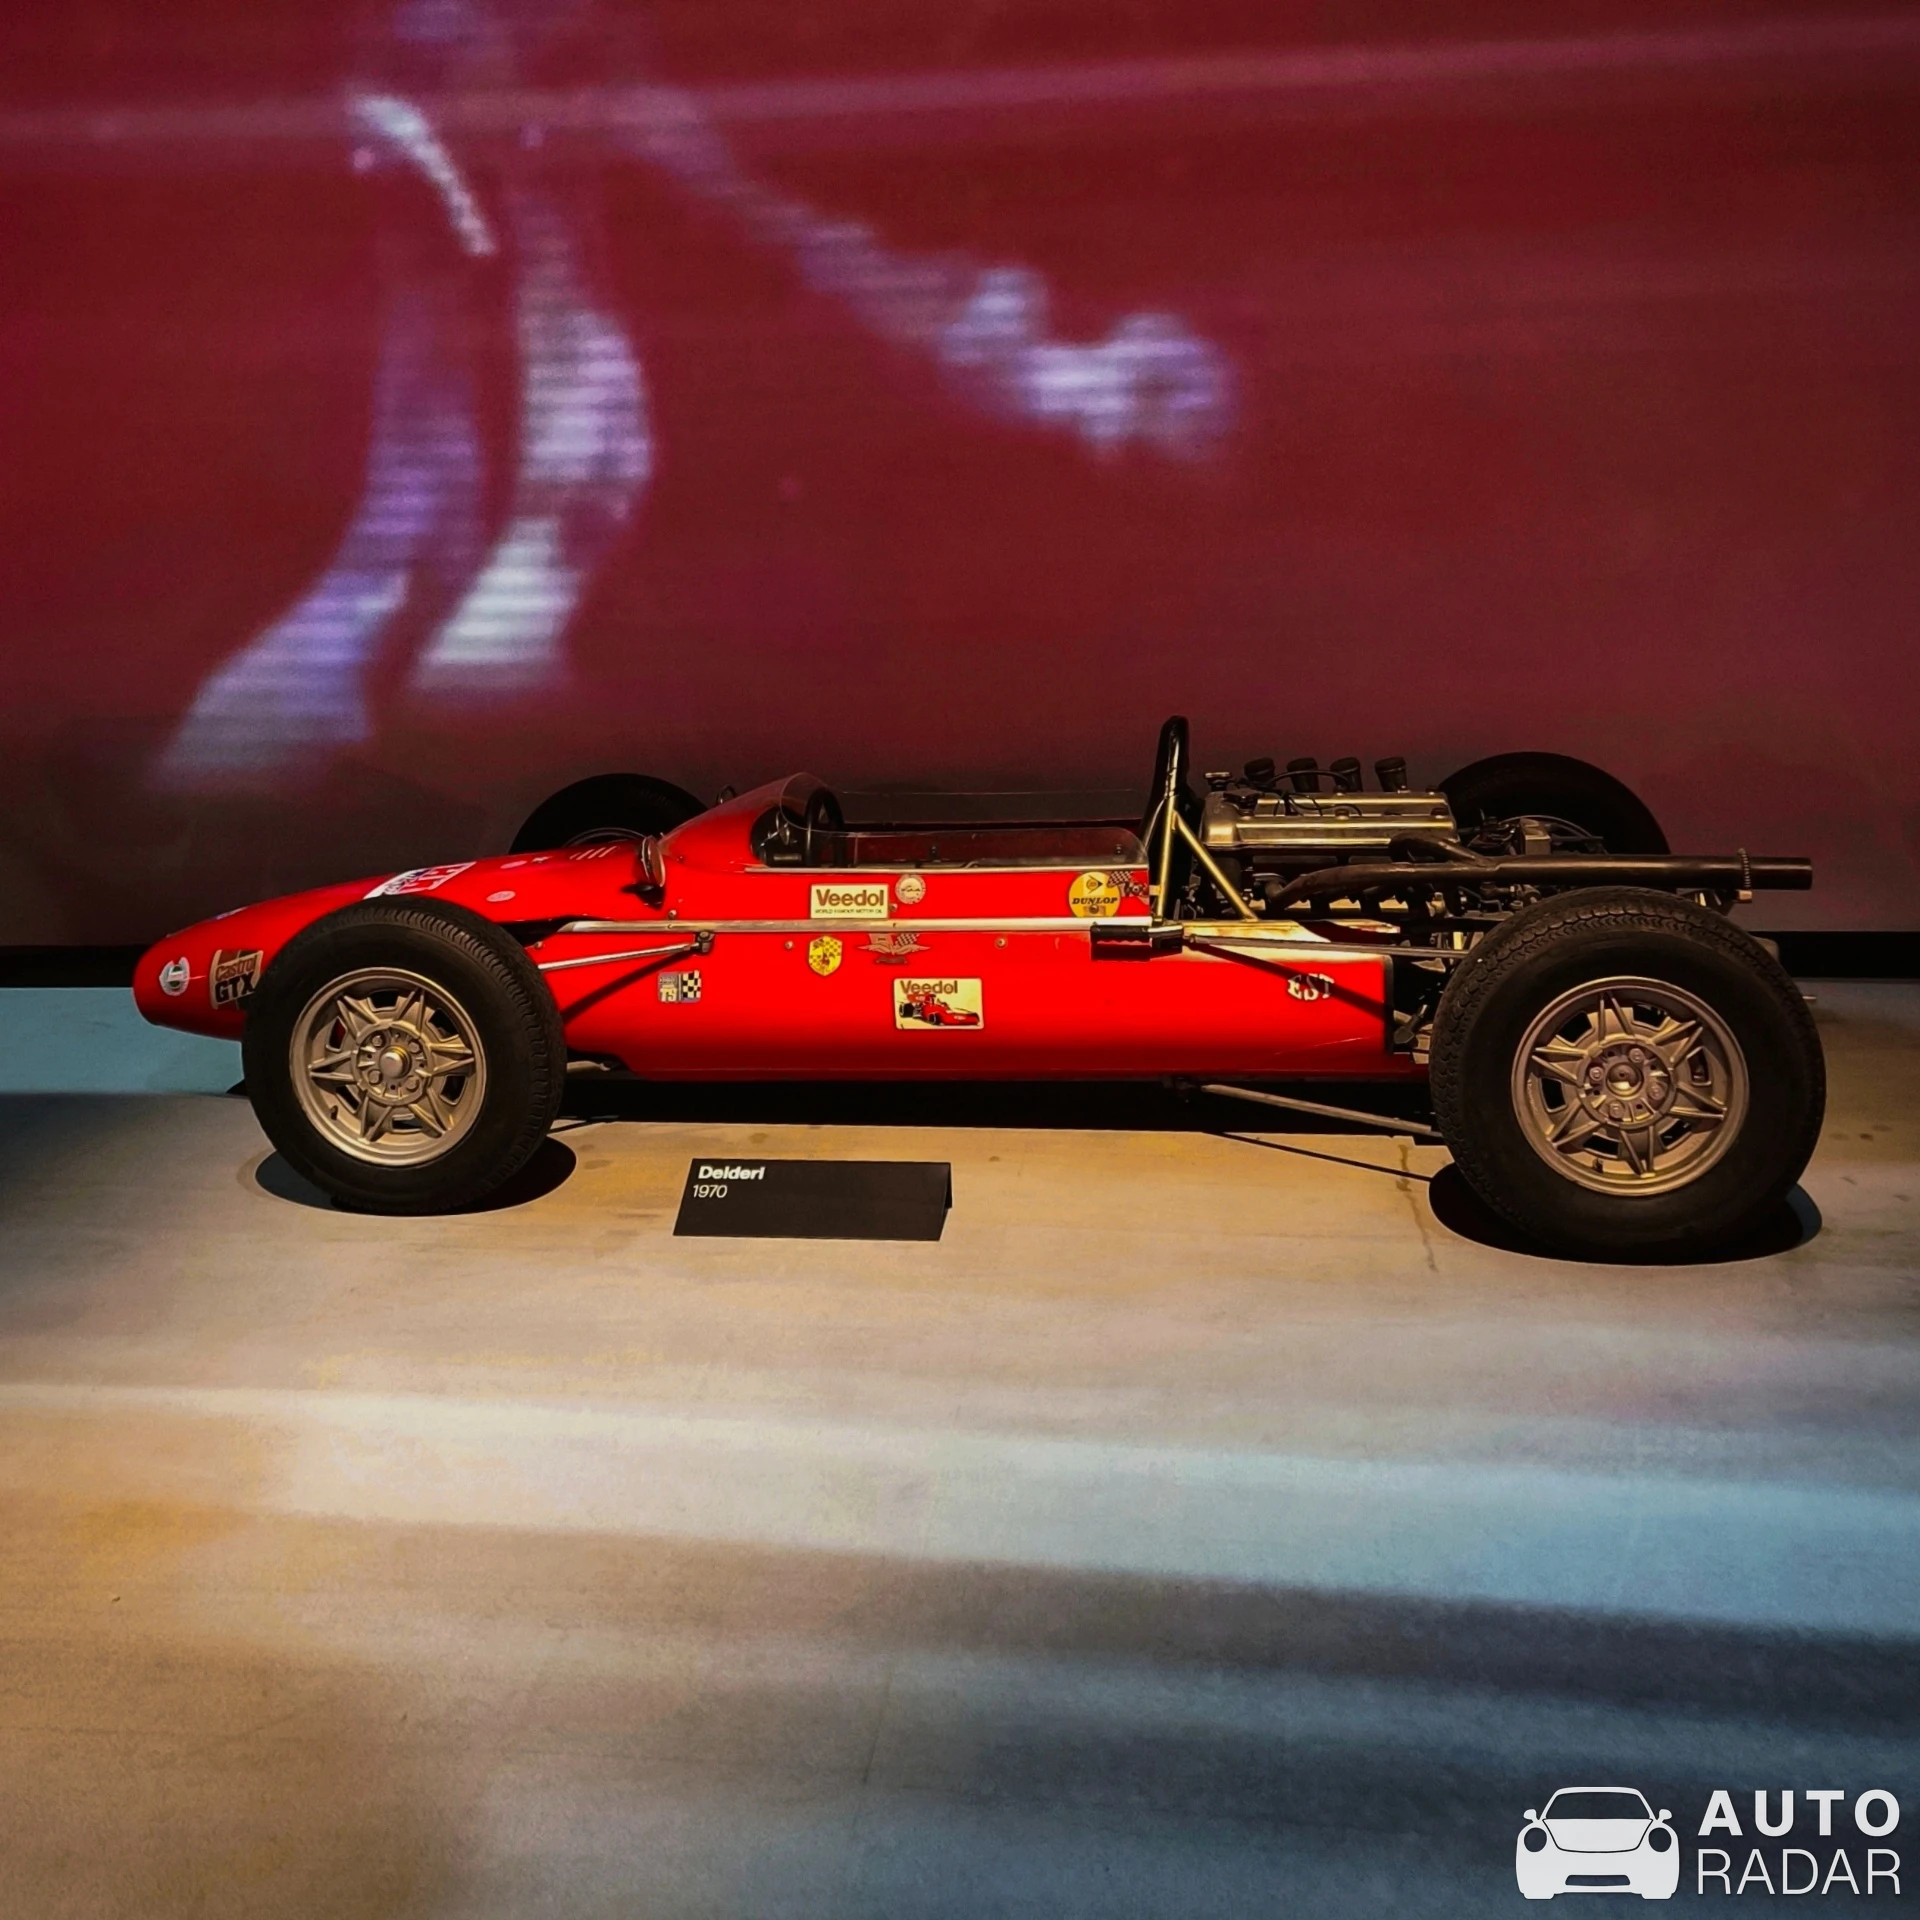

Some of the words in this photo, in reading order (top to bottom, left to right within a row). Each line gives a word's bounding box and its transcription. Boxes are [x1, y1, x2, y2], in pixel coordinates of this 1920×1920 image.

[816, 889, 885, 906] Veedol
[1072, 897, 1118, 905] DUNLOP
[215, 971, 255, 1003] GTX
[900, 980, 958, 994] Veedol
[1288, 973, 1334, 1001] EST
[693, 1184, 728, 1198] 1970
